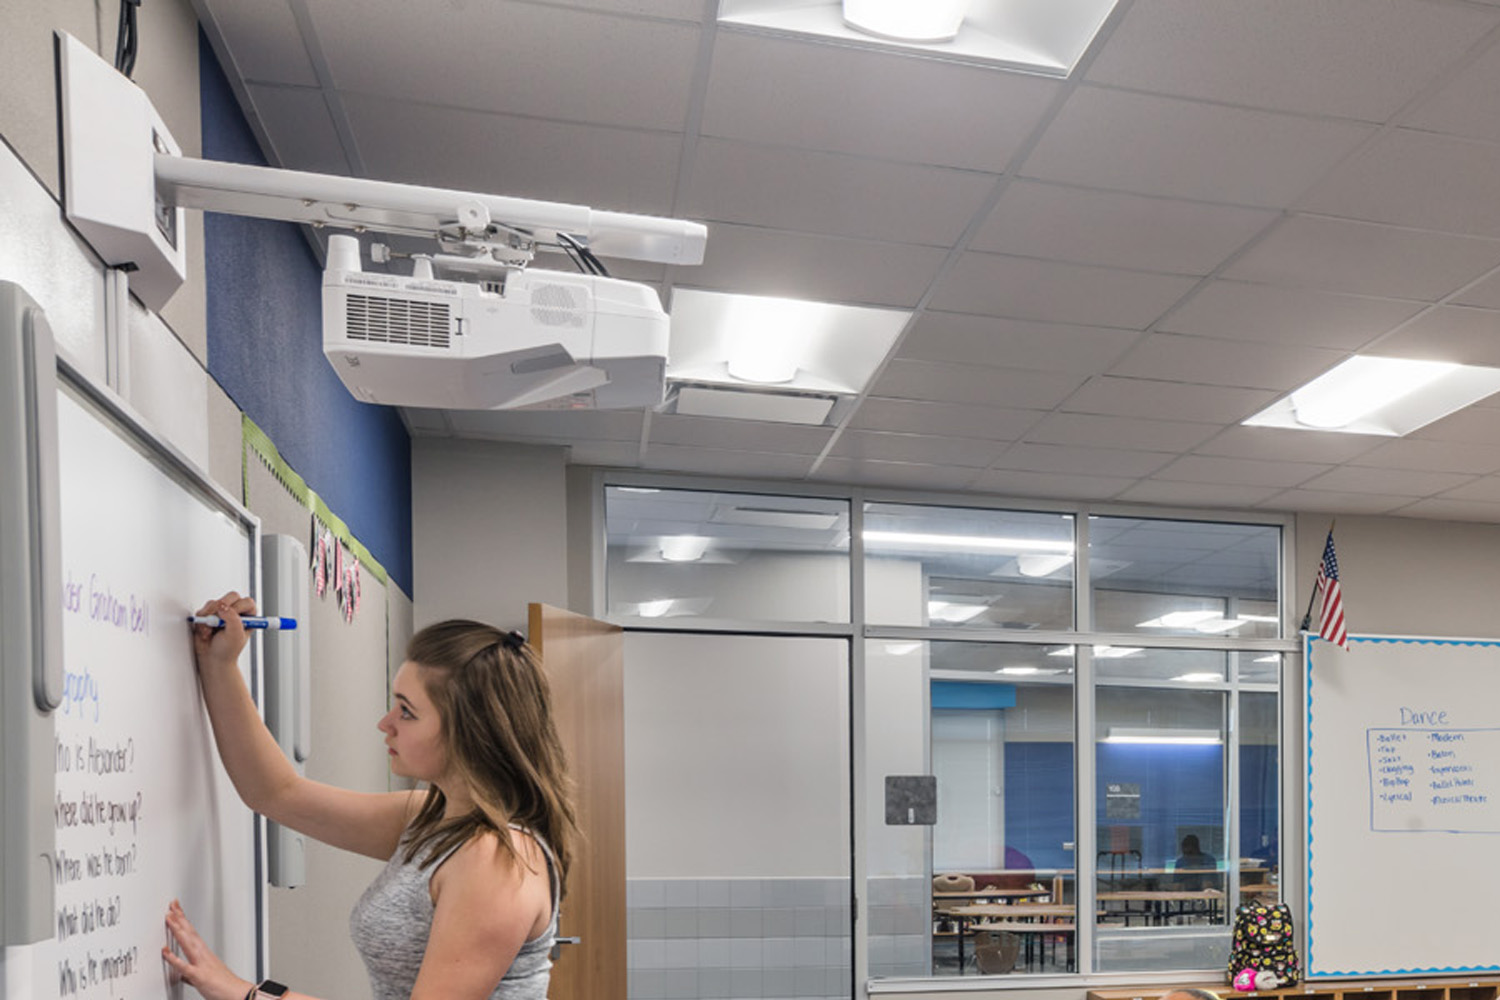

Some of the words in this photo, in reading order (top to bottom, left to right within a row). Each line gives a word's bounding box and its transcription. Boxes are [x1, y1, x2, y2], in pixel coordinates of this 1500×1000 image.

[130, 594, 149, 637] Bell
[63, 667, 99, 723] graphy
[1400, 707, 1449, 725] Dance
